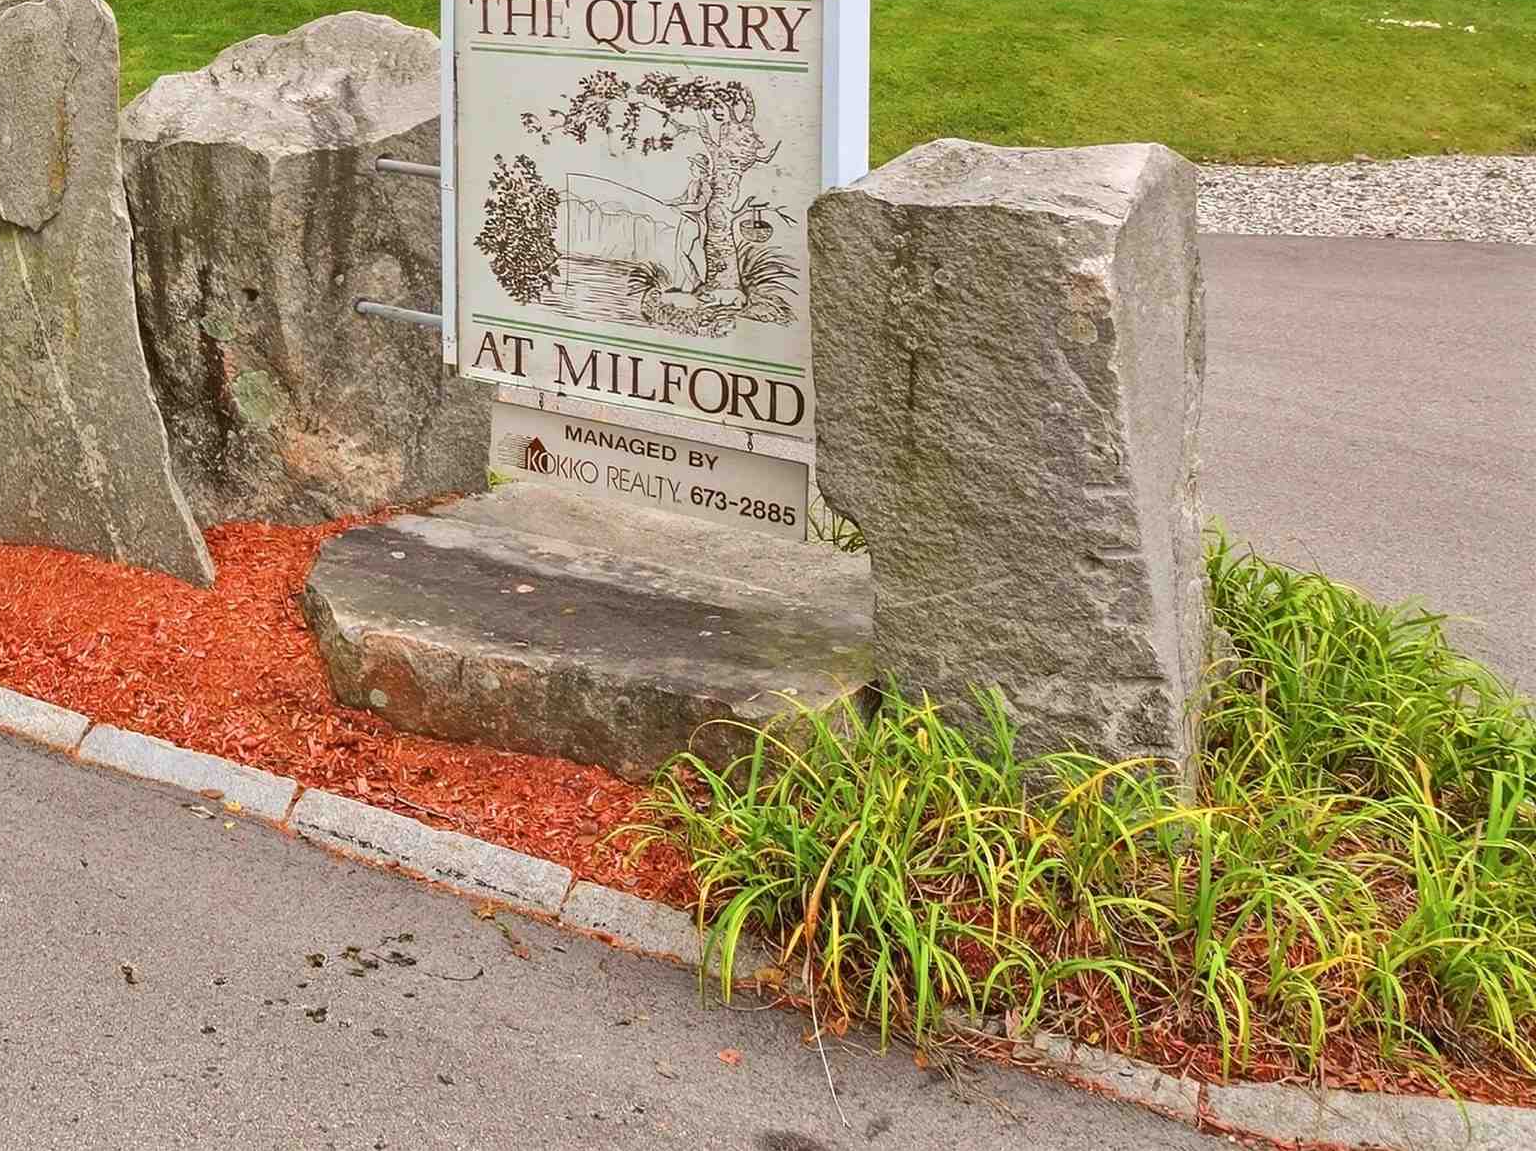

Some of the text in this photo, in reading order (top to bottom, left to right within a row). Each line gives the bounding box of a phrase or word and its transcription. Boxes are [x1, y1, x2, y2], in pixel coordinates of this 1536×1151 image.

[471, 330, 806, 427] AT MILFORD
[525, 447, 600, 484] KOKKO
[690, 485, 797, 526] 673-2885
[564, 424, 720, 471] MANAGED BY
